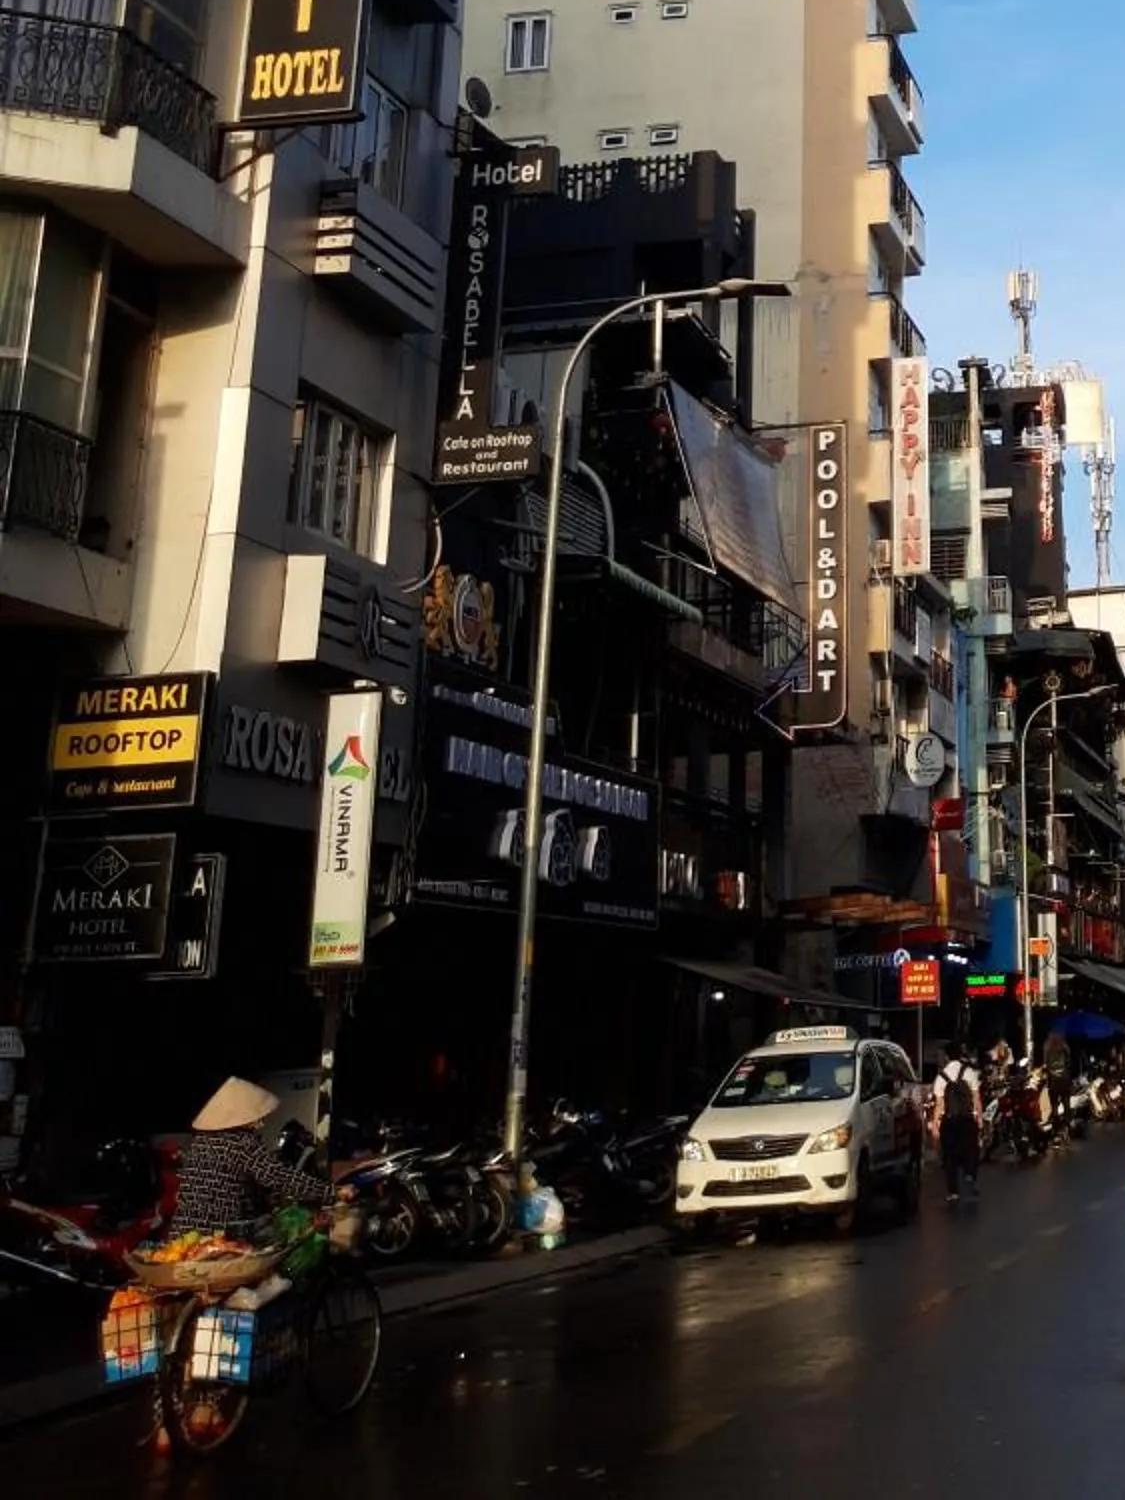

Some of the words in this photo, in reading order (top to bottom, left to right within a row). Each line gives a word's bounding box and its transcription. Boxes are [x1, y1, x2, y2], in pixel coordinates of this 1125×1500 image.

[251, 46, 345, 101] HOTEL
[472, 158, 542, 187] Hotel
[900, 364, 922, 480] HAPPY
[443, 457, 529, 476] Restaurant
[901, 493, 922, 566] INN
[75, 683, 190, 716] MERAKI
[69, 728, 183, 757] ROOFTOP
[333, 785, 352, 872] VINAMA
[51, 882, 154, 915] MERAKI
